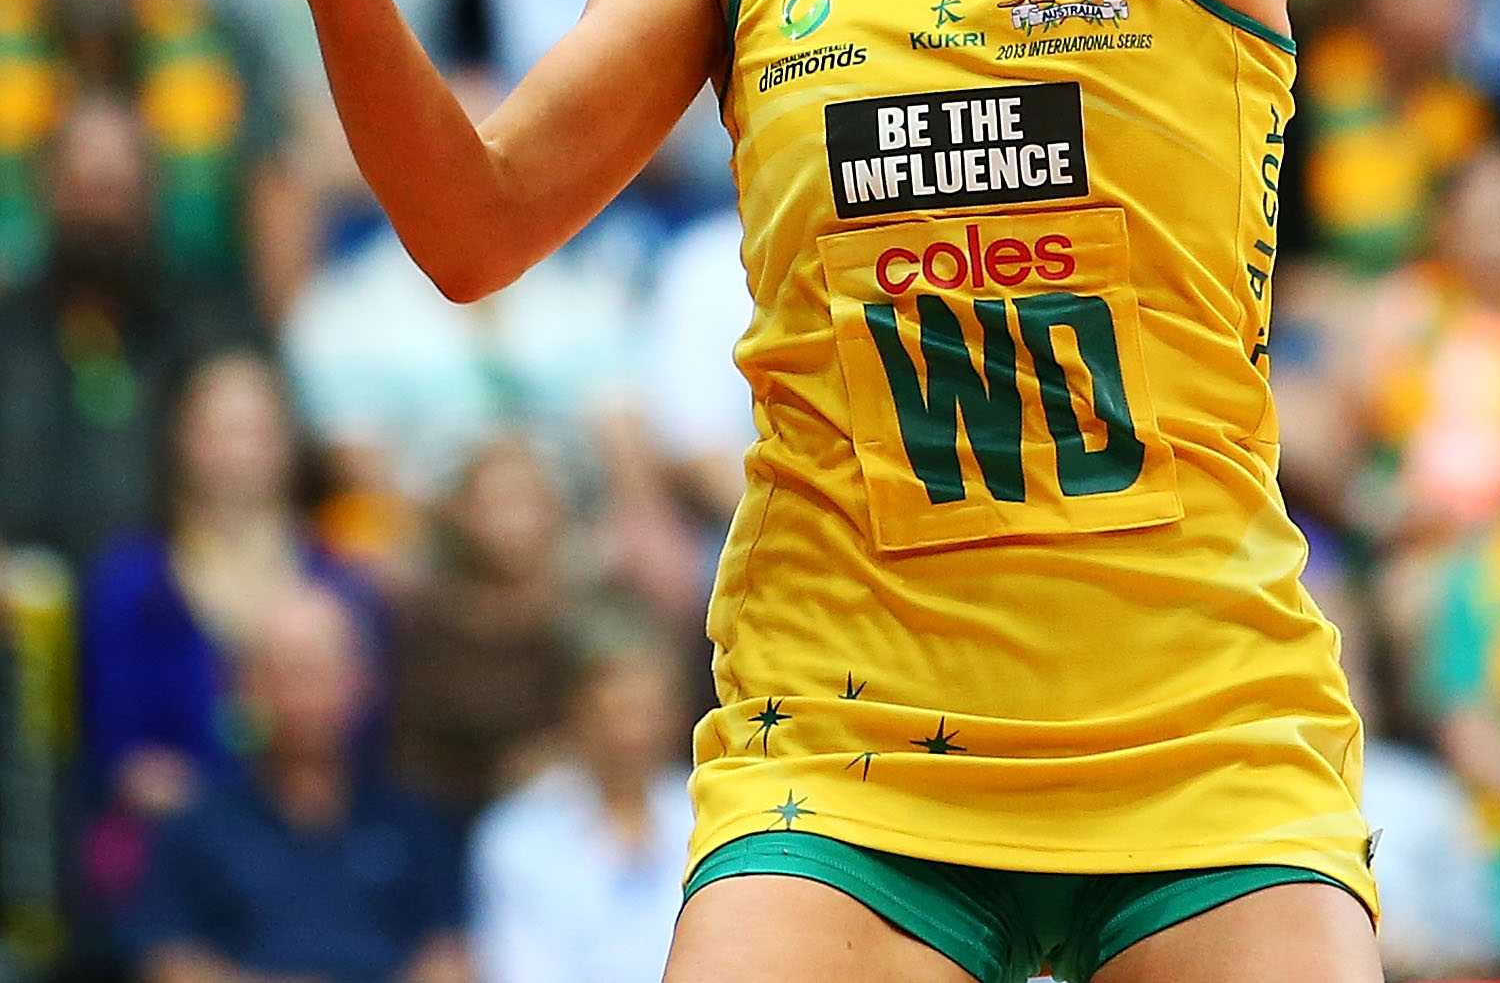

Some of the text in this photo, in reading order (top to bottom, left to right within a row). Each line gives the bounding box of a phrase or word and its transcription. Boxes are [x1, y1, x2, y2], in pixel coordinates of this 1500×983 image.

[1042, 5, 1103, 22] AUSTRALIA
[910, 32, 985, 50] KUKRI
[996, 34, 1152, 60] 2013 INTERNATIONAL SERIES
[759, 43, 867, 92] diamonds
[877, 97, 1023, 151] BE THE
[841, 142, 1073, 204] INFLUENCE
[875, 224, 1076, 295] coles
[864, 292, 1145, 504] WD
